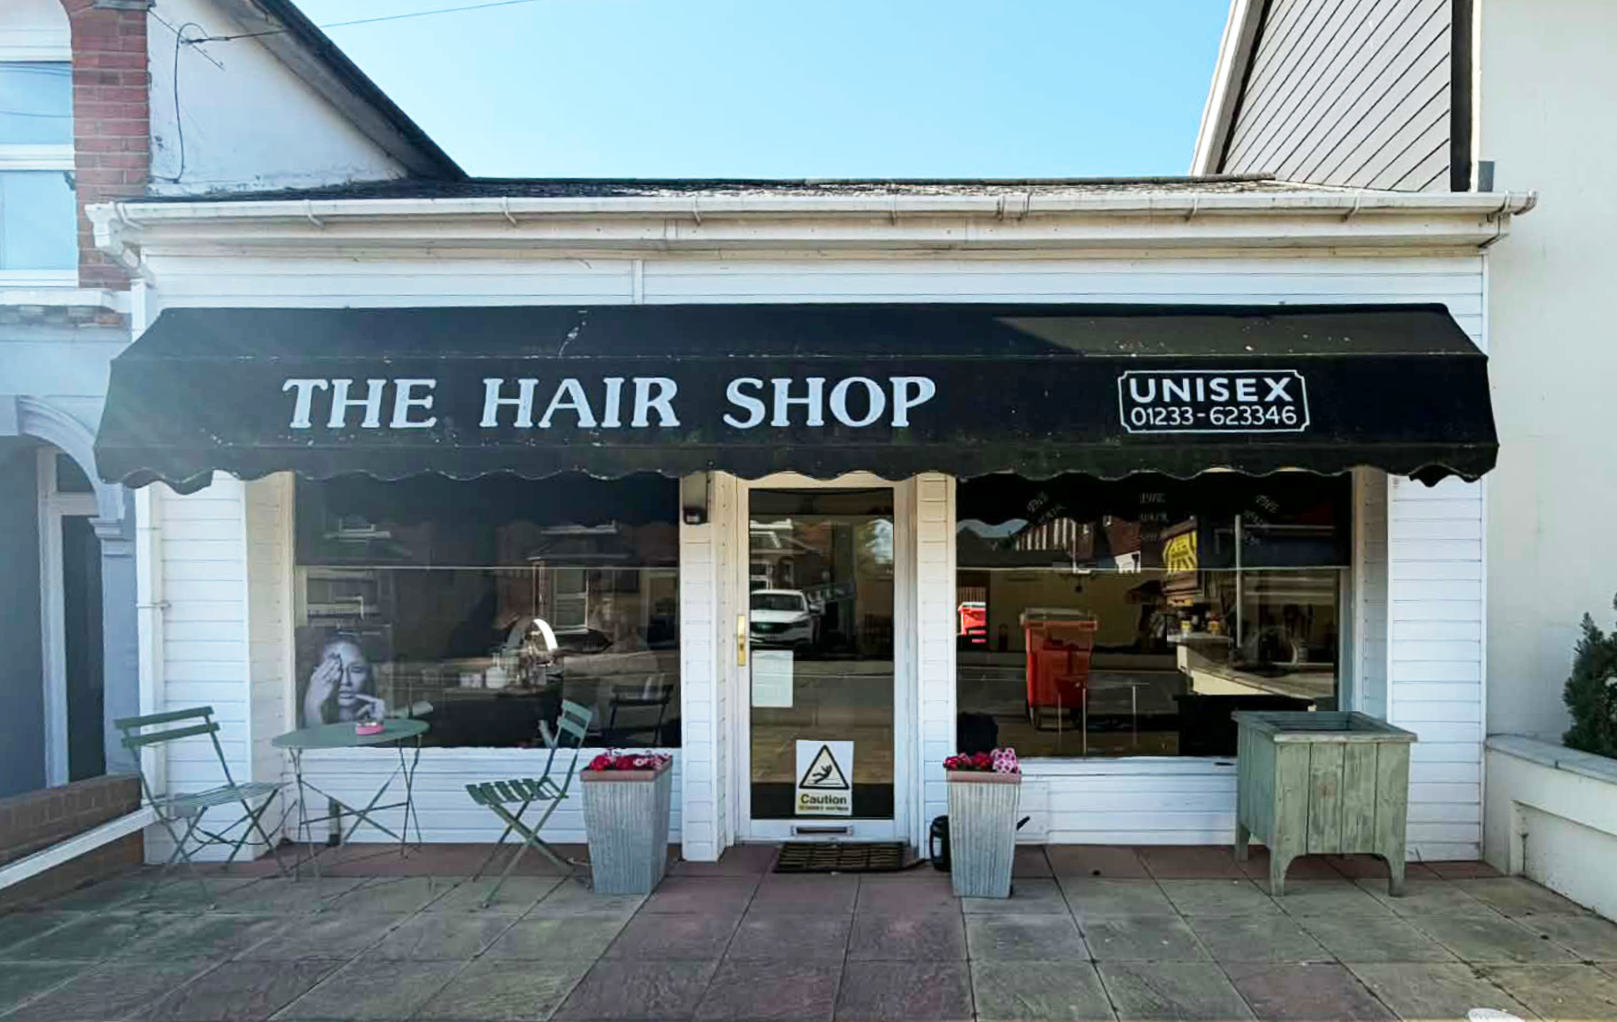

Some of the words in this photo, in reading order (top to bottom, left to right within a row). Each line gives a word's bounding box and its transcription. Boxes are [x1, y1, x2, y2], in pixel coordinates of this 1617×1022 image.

[1129, 377, 1294, 403] UNISEX
[282, 377, 437, 429] THE
[479, 377, 681, 429] HAIR
[723, 376, 936, 429] SHOP
[1130, 405, 1298, 426] 01233-623346
[800, 793, 848, 805] Caution
